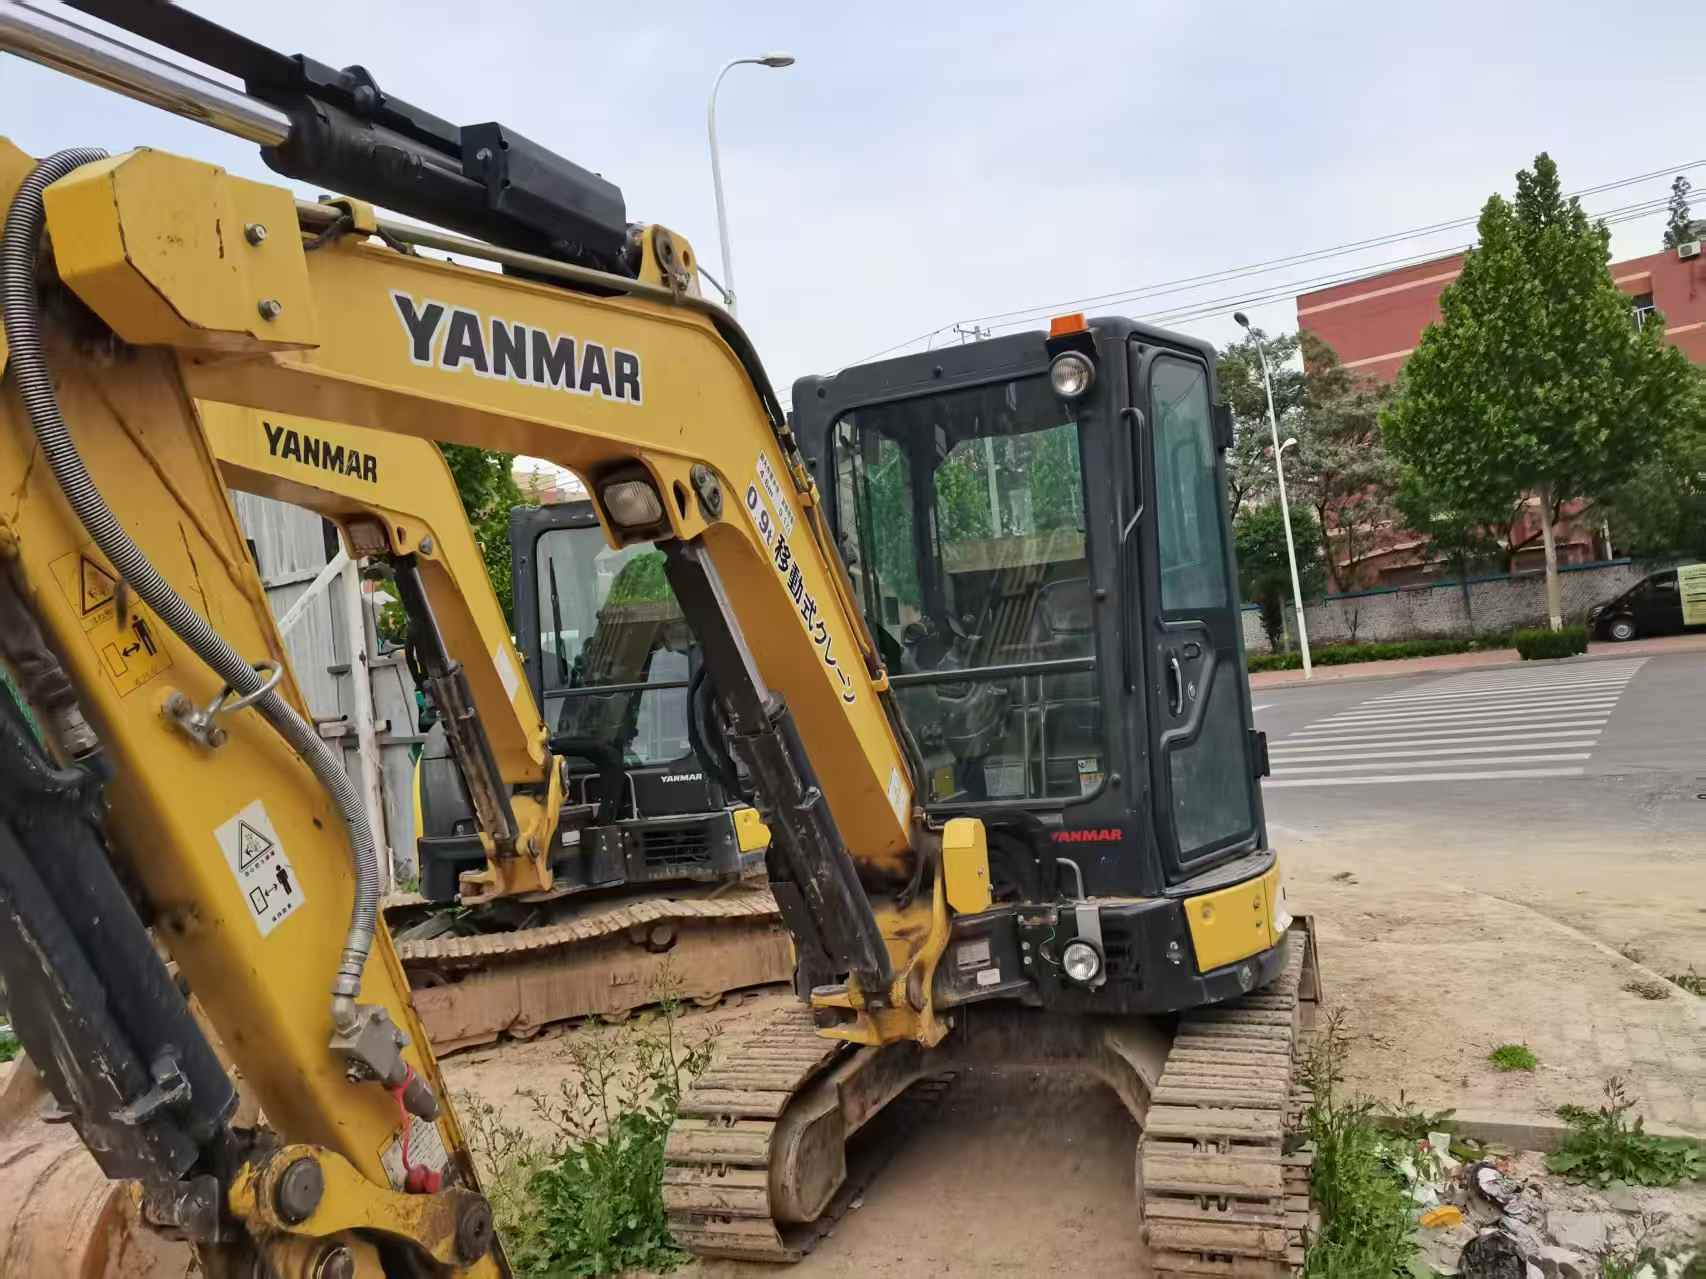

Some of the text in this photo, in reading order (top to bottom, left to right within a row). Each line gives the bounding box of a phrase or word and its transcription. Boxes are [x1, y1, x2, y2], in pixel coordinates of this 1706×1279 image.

[391, 291, 642, 403] YANMAR
[262, 421, 378, 483] YANMAR
[774, 533, 856, 703] 移動式クレーン
[660, 773, 703, 783] YANMAR
